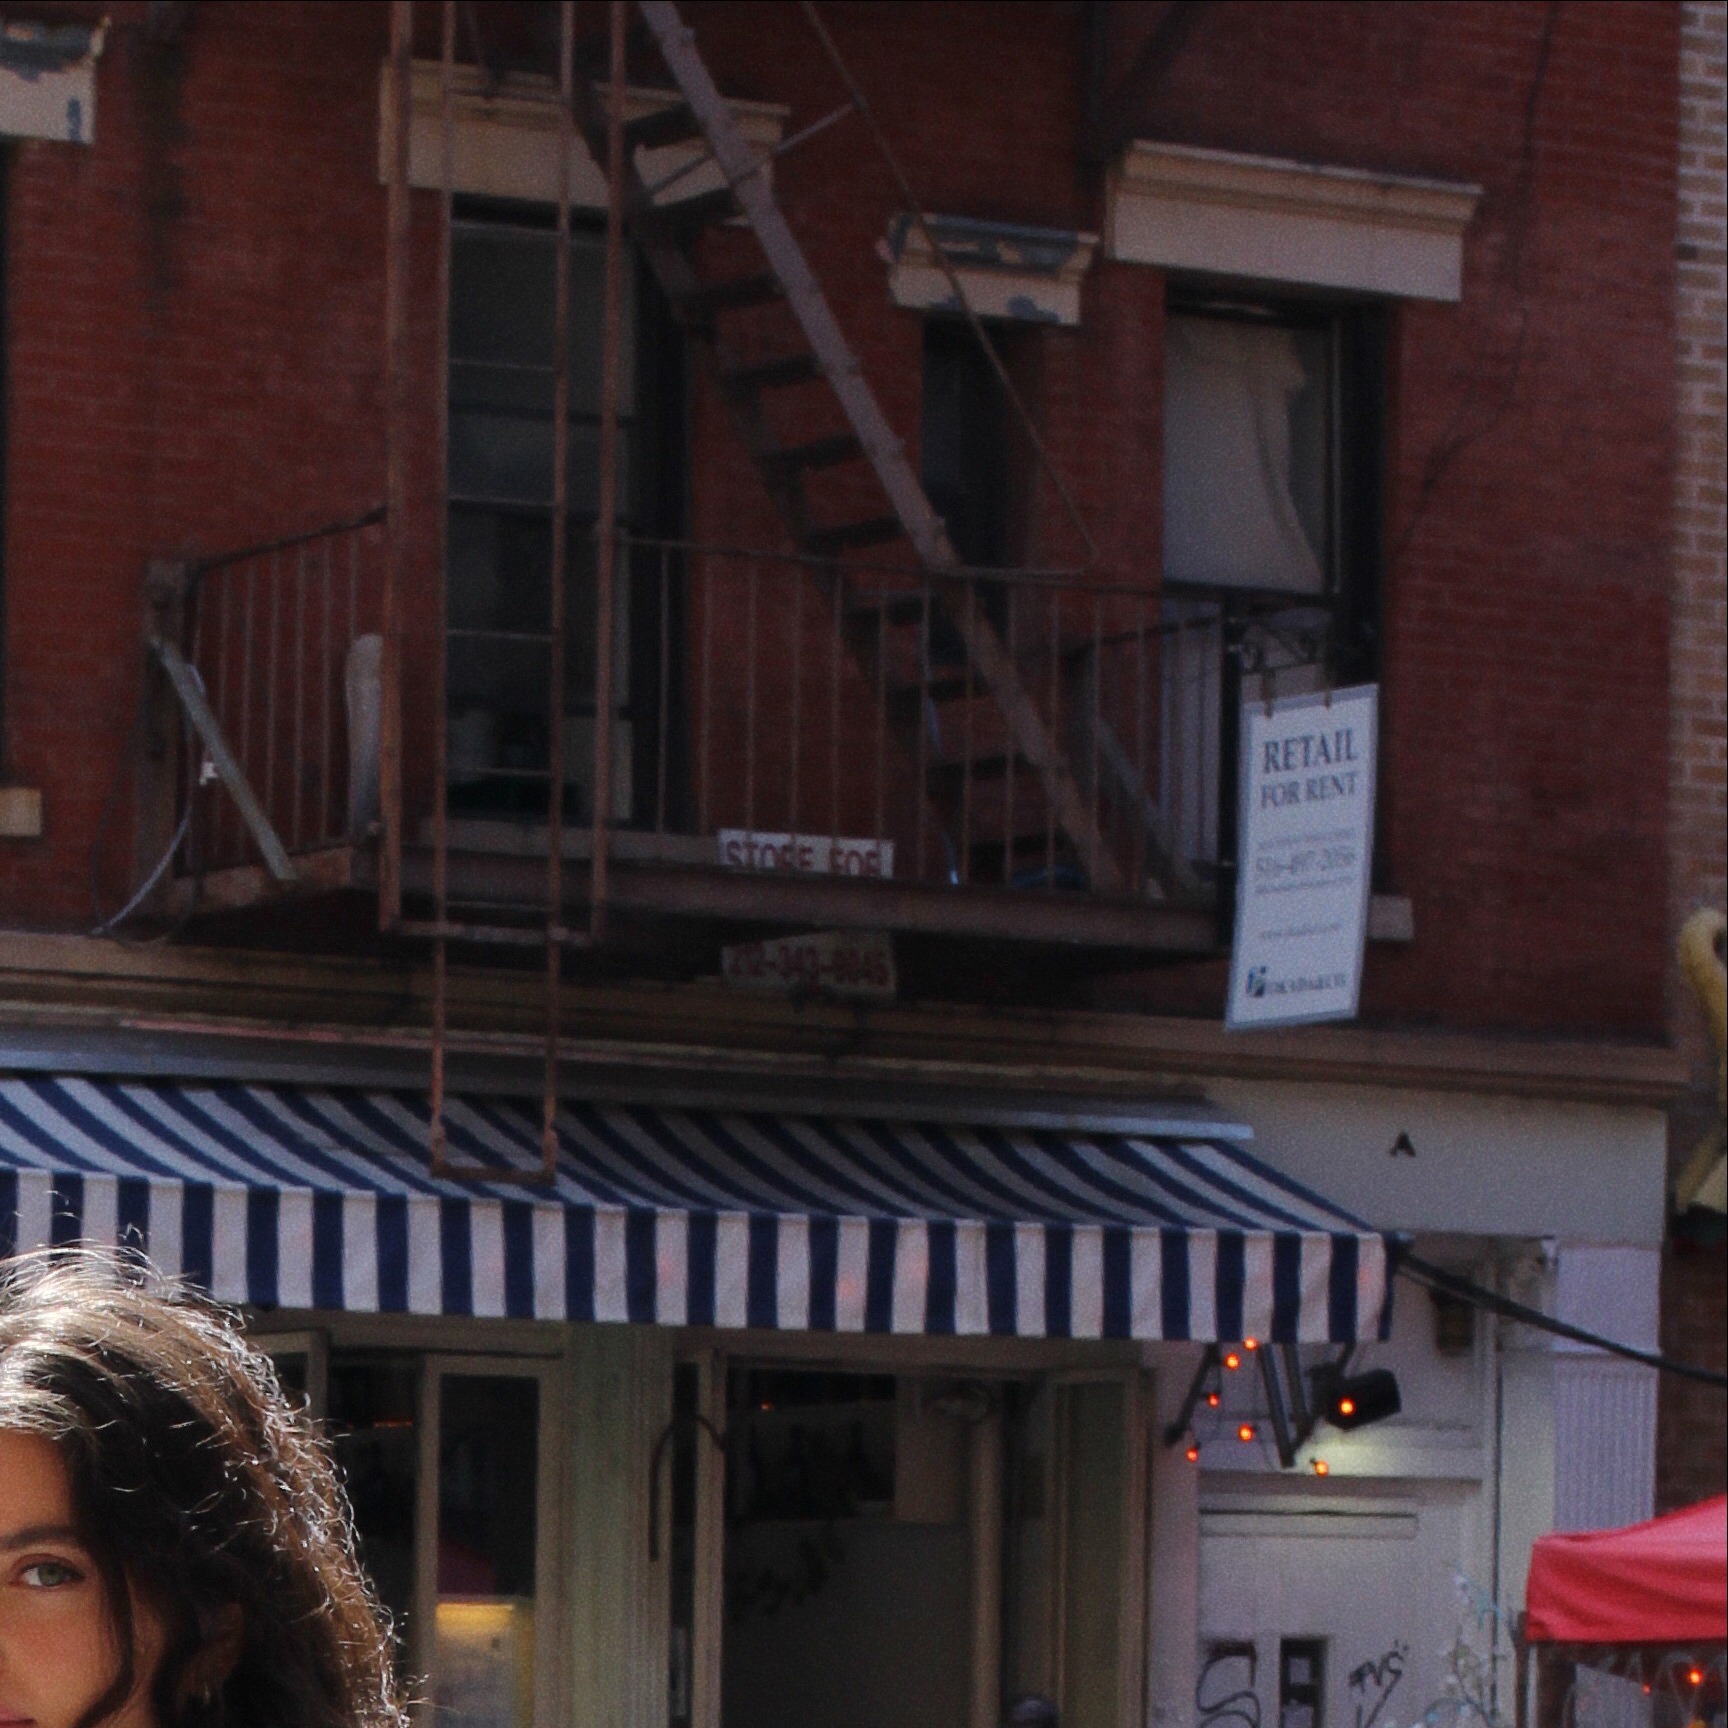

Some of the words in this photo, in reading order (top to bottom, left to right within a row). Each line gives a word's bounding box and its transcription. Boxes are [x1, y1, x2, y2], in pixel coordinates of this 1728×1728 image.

[1262, 729, 1359, 774] RETAIL
[1260, 779, 1300, 808] FOR
[1305, 771, 1358, 802] RENT
